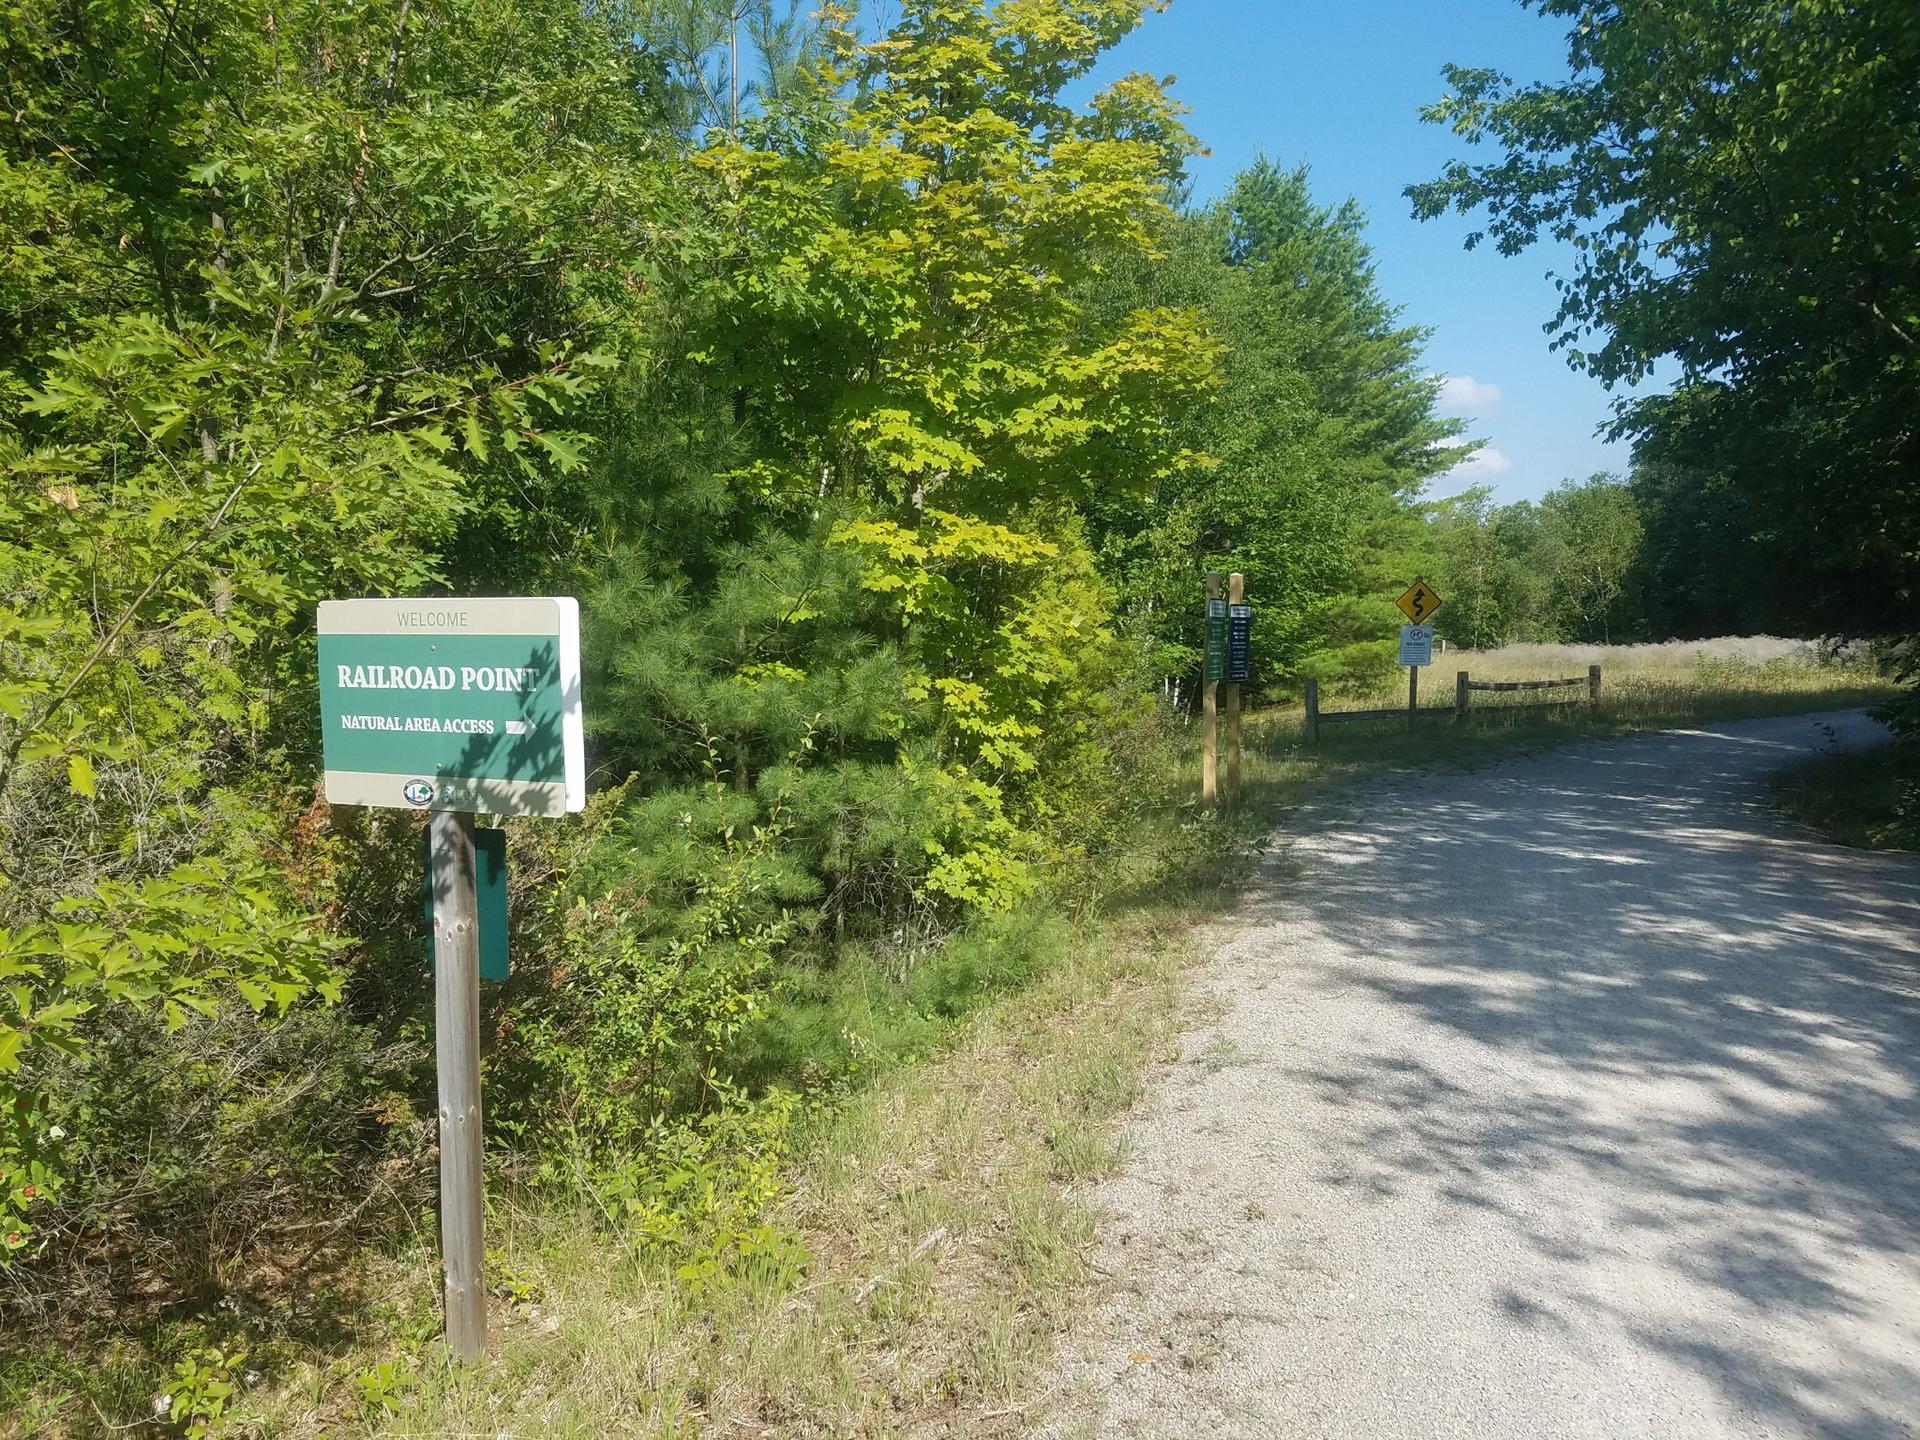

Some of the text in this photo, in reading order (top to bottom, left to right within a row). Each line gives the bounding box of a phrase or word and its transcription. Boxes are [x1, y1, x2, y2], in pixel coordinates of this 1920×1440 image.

[397, 612, 468, 627] WELCOME
[337, 665, 540, 692] RAILROAD POINT
[341, 715, 494, 734] NATURAL AREA ACCESS
